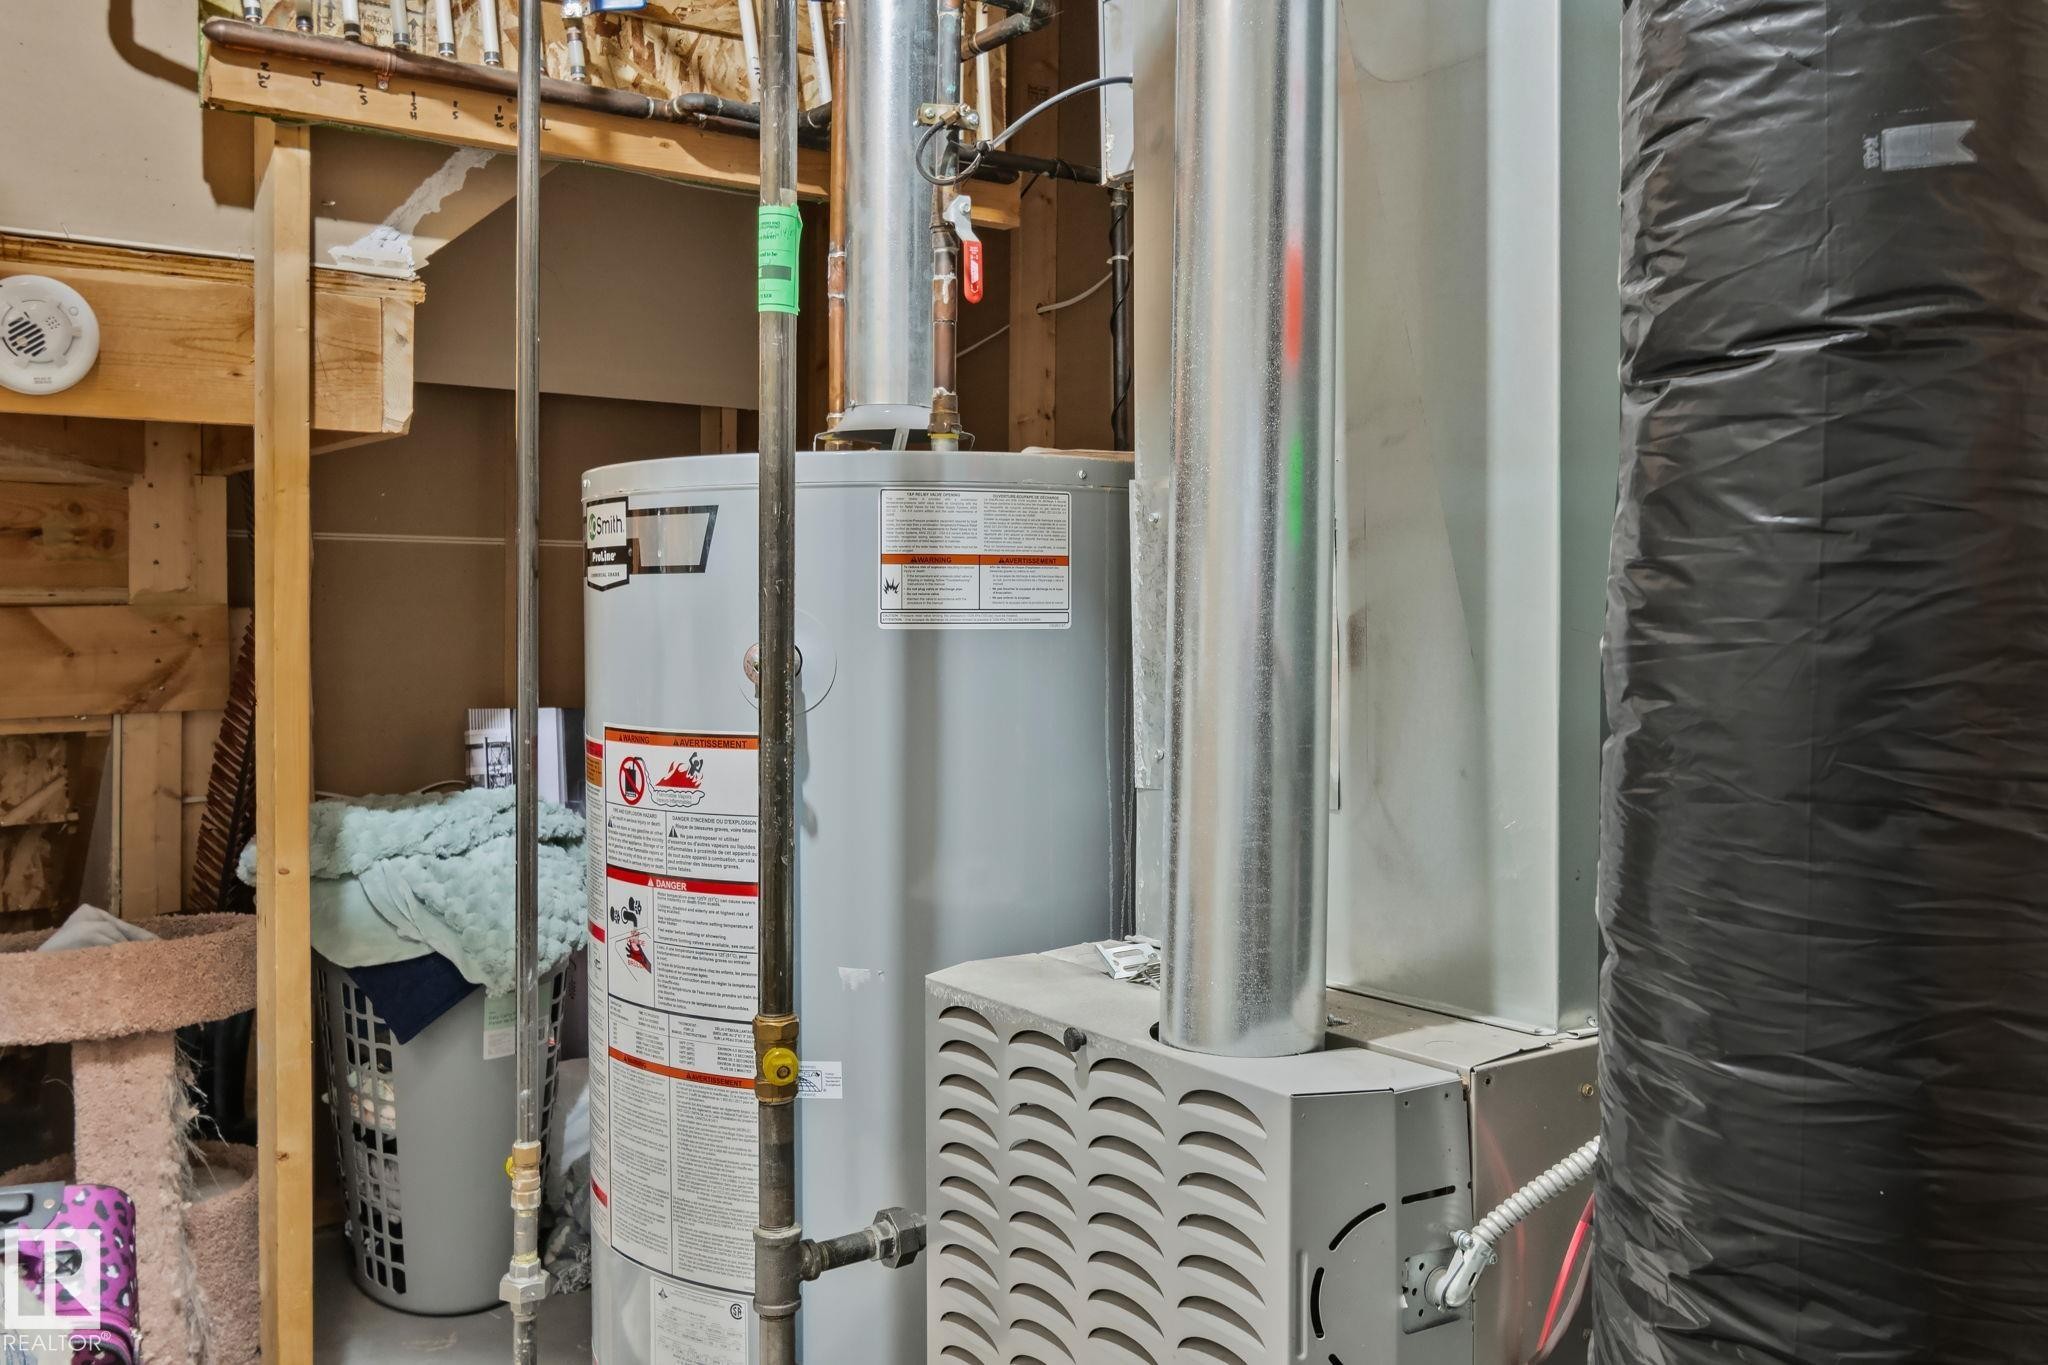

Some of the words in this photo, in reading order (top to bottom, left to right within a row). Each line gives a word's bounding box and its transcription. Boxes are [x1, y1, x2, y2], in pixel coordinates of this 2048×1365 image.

[596, 513, 624, 536] Smith
[623, 734, 650, 744] WARNING
[680, 739, 747, 749] AVERTISSEMENT
[656, 879, 687, 891] DANGER
[692, 1074, 742, 1087] AVERTISSEMENT
